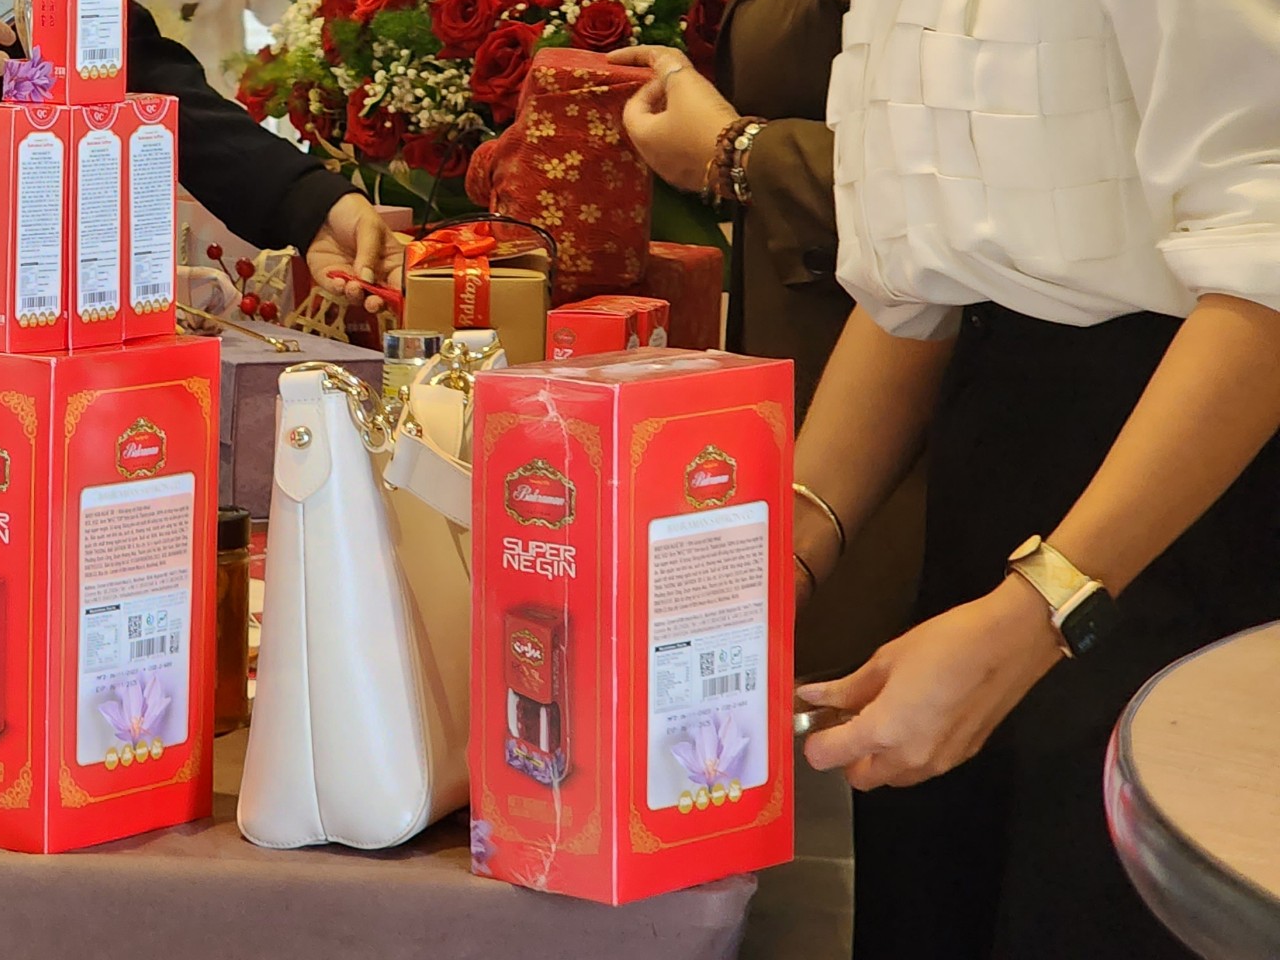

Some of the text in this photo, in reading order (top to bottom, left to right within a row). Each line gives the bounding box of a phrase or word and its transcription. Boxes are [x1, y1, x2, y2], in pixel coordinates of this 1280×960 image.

[36, 109, 47, 119] QC
[146, 104, 157, 114] QC
[93, 111, 104, 121] QC
[502, 537, 577, 562] SUPER
[502, 552, 577, 581] NEGIN
